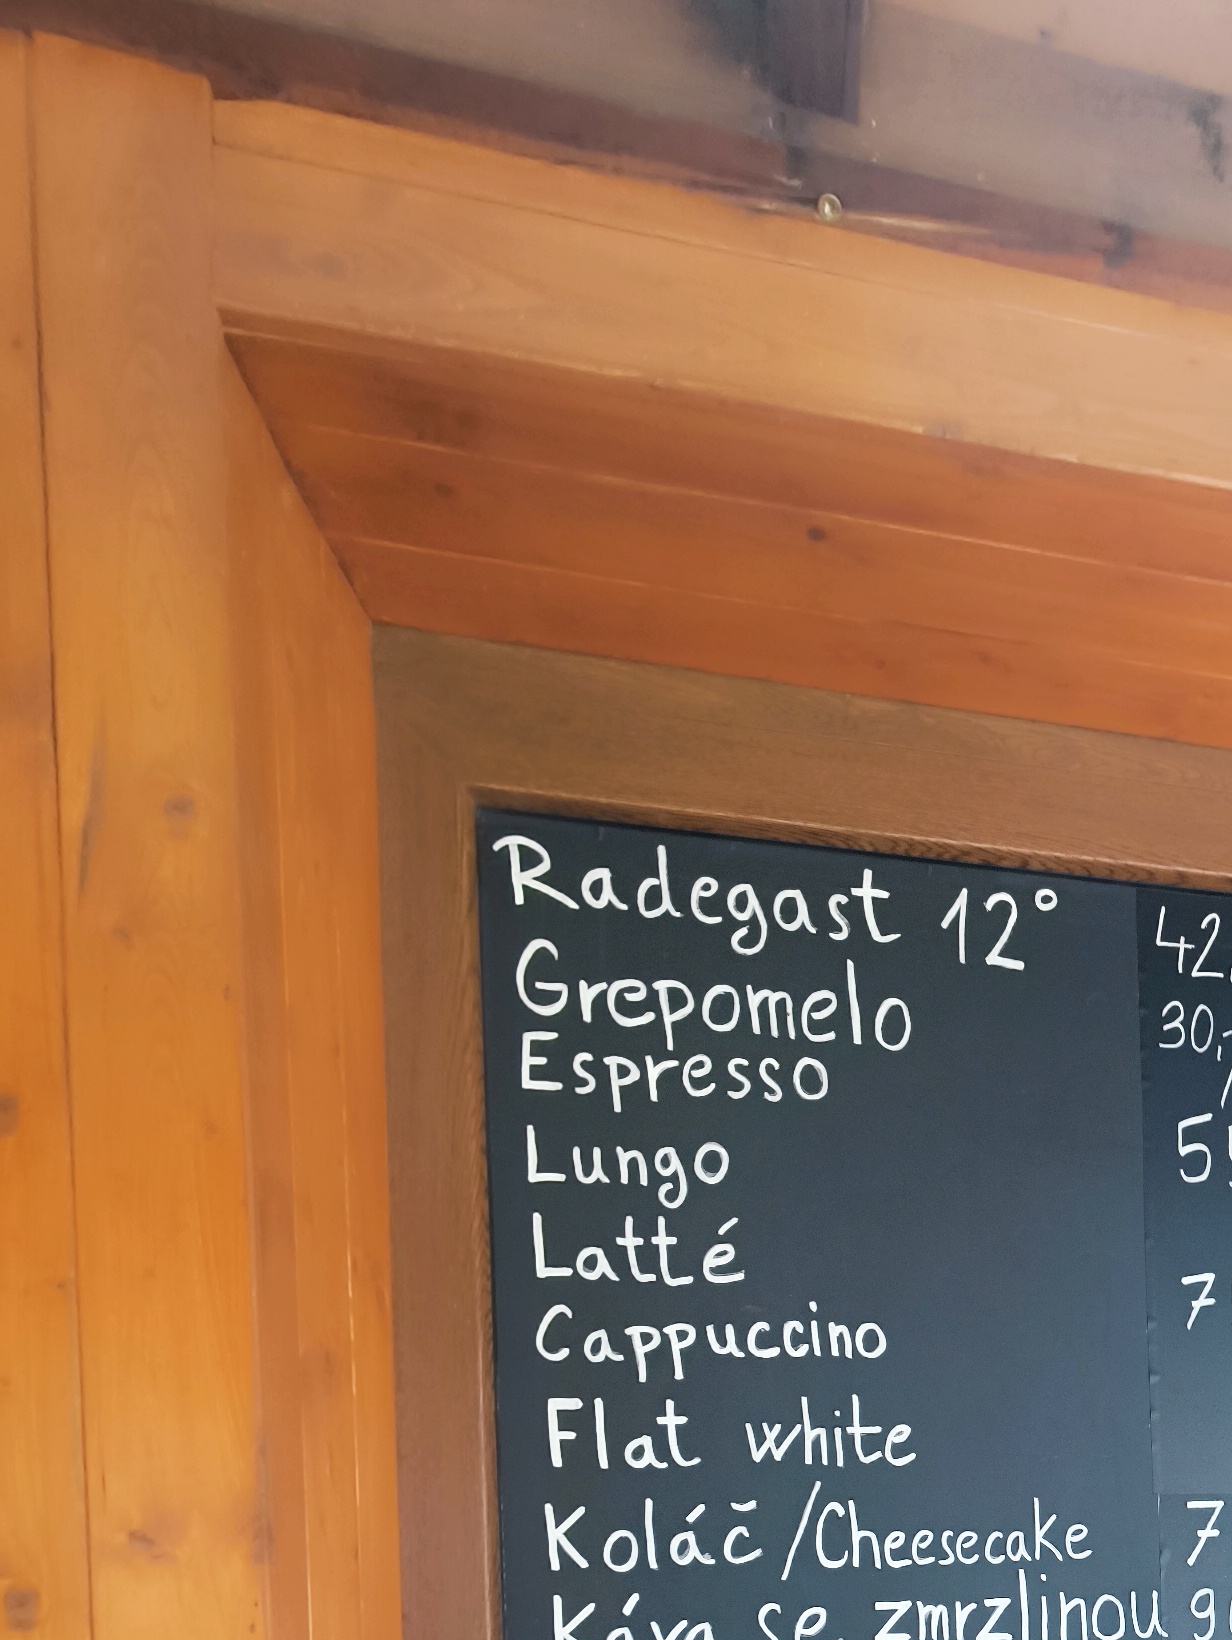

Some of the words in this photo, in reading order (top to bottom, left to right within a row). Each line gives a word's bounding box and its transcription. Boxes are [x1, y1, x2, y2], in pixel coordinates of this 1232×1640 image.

[492, 834, 902, 956] Radegast
[940, 888, 1059, 971] 12°
[515, 938, 912, 1053] Grepomelo
[521, 1030, 830, 1113] Espresso
[526, 1124, 731, 1210] Lungo
[532, 1211, 746, 1287] Latté
[535, 1300, 888, 1383] Cappuccino
[547, 1397, 702, 1469] Flat
[745, 1393, 918, 1468] white
[544, 1496, 765, 1573] Koláč
